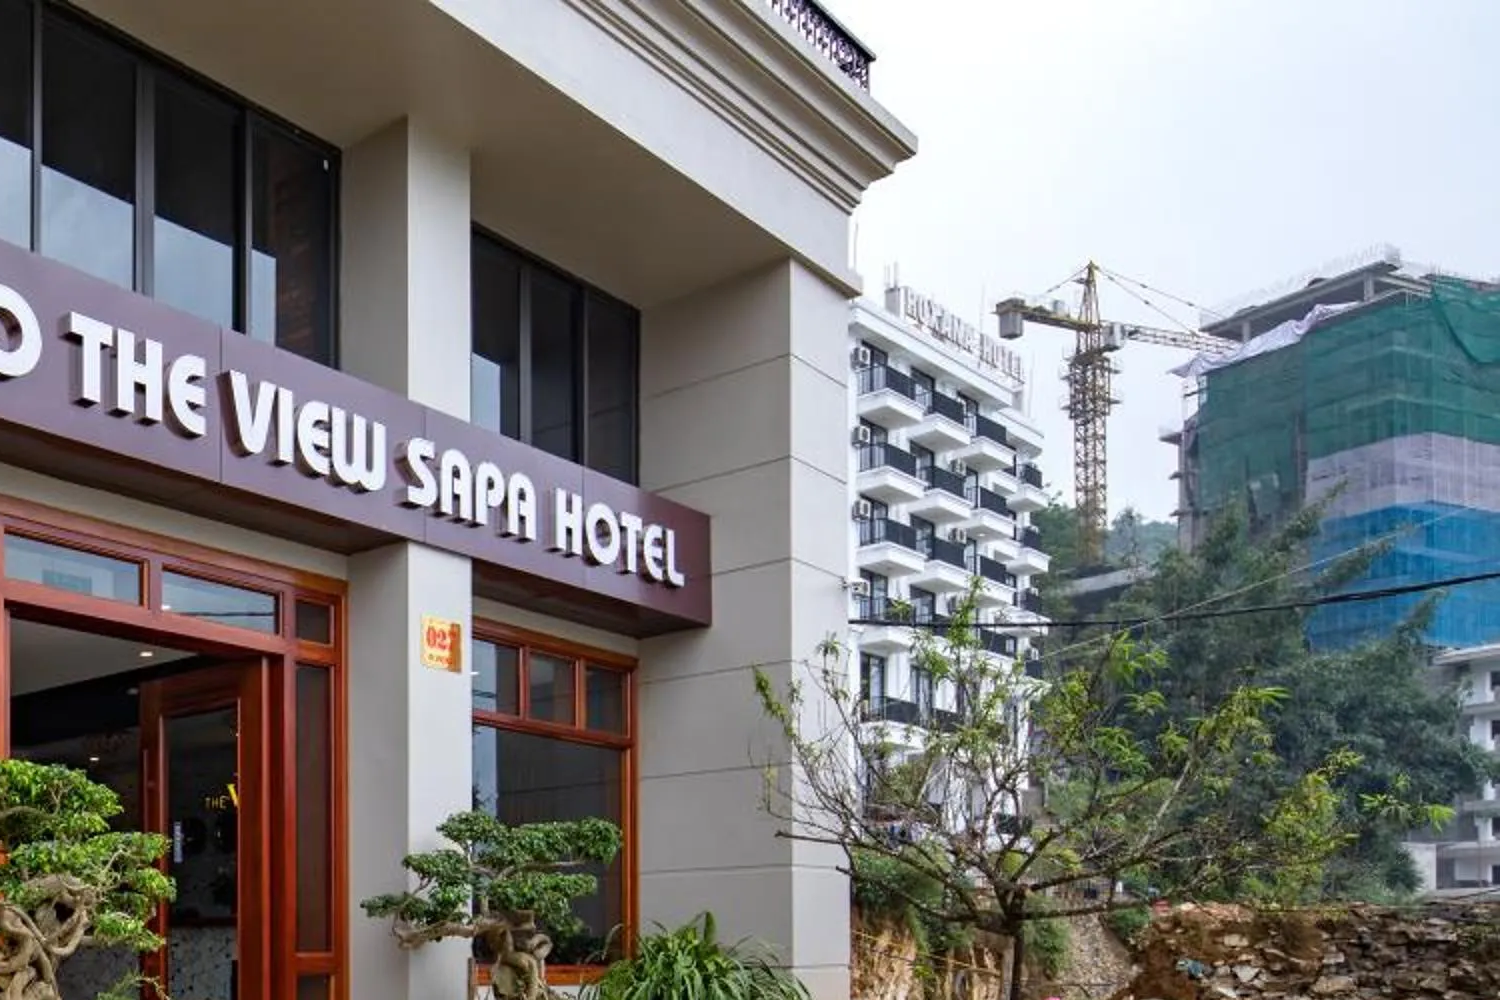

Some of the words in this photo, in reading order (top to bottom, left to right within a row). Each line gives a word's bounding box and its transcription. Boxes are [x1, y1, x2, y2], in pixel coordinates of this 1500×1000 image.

[68, 311, 207, 437] THE
[226, 369, 386, 492] VIEW
[405, 437, 537, 542] SAPA
[553, 487, 685, 588] HOTEL
[204, 795, 229, 810] THE
